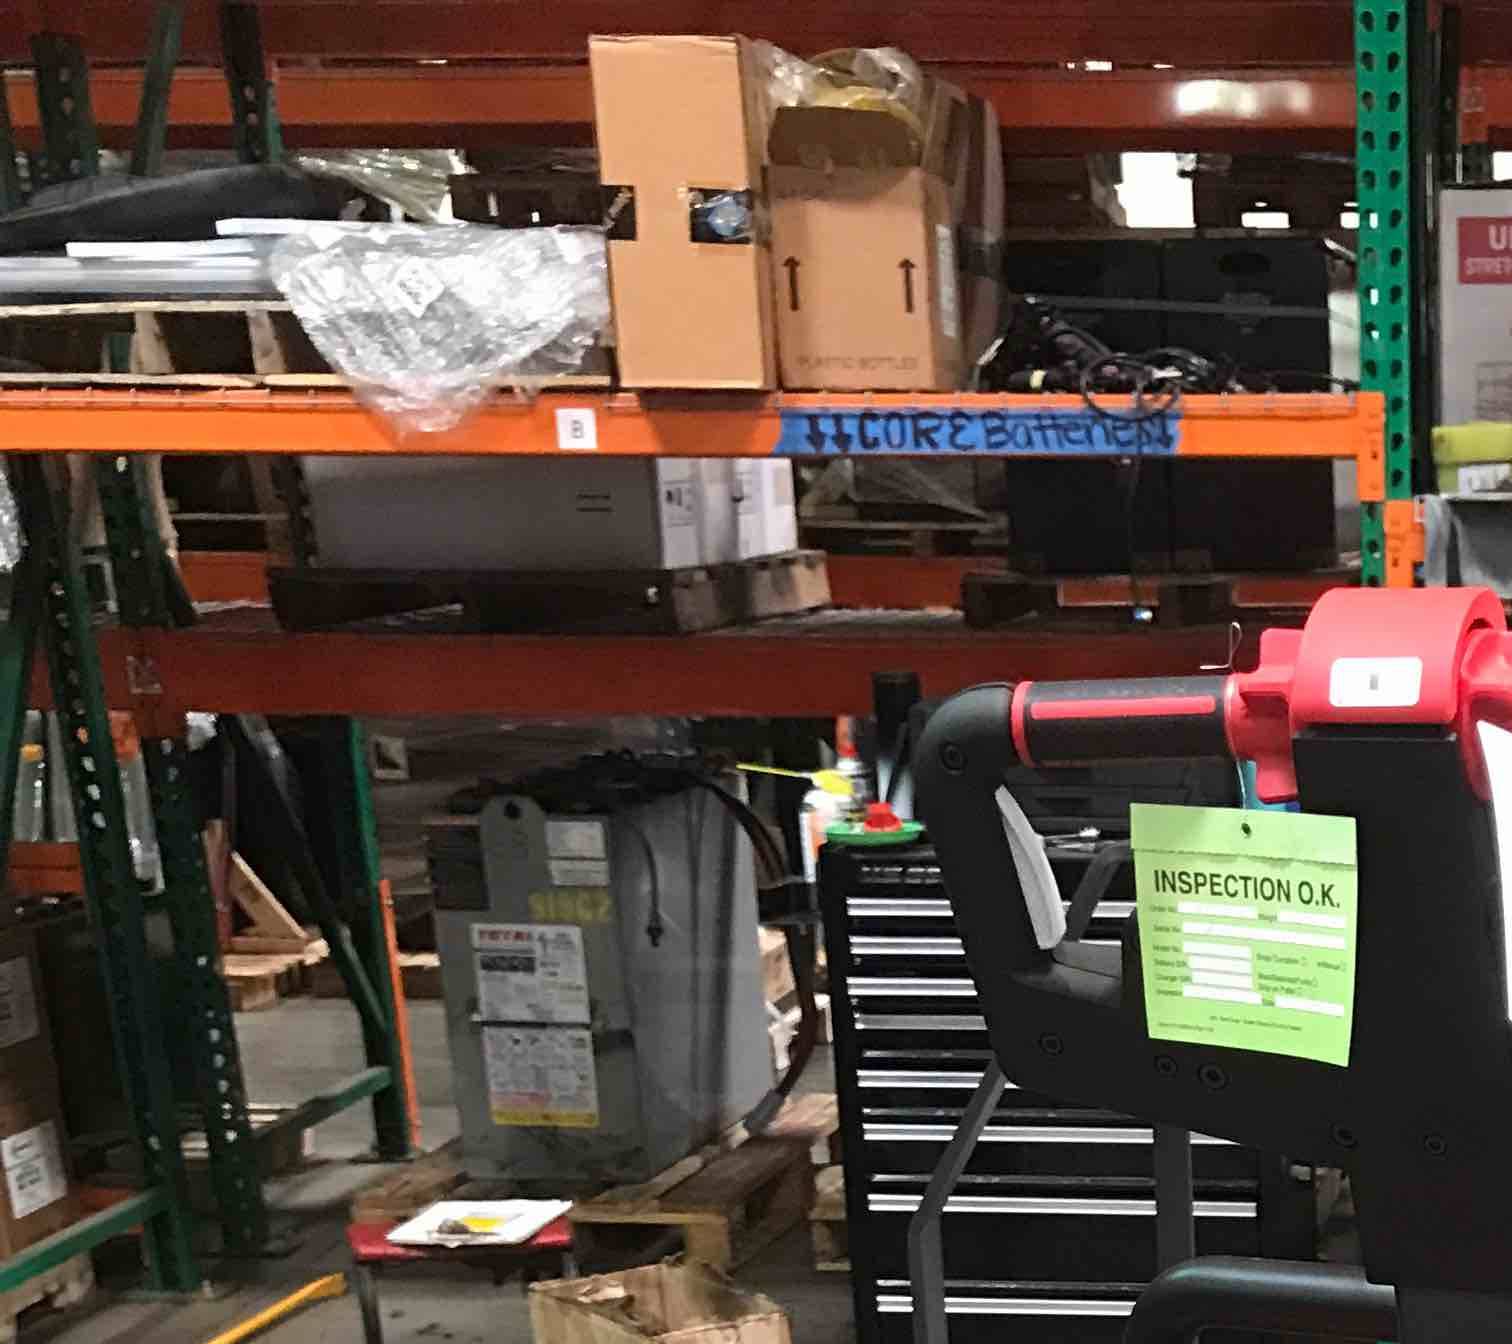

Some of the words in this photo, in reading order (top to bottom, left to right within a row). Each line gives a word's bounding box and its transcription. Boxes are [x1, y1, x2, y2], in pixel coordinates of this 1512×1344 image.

[858, 410, 975, 451] CORE
[1152, 868, 1292, 903] INSPECTION
[1297, 880, 1341, 909] O.K.
